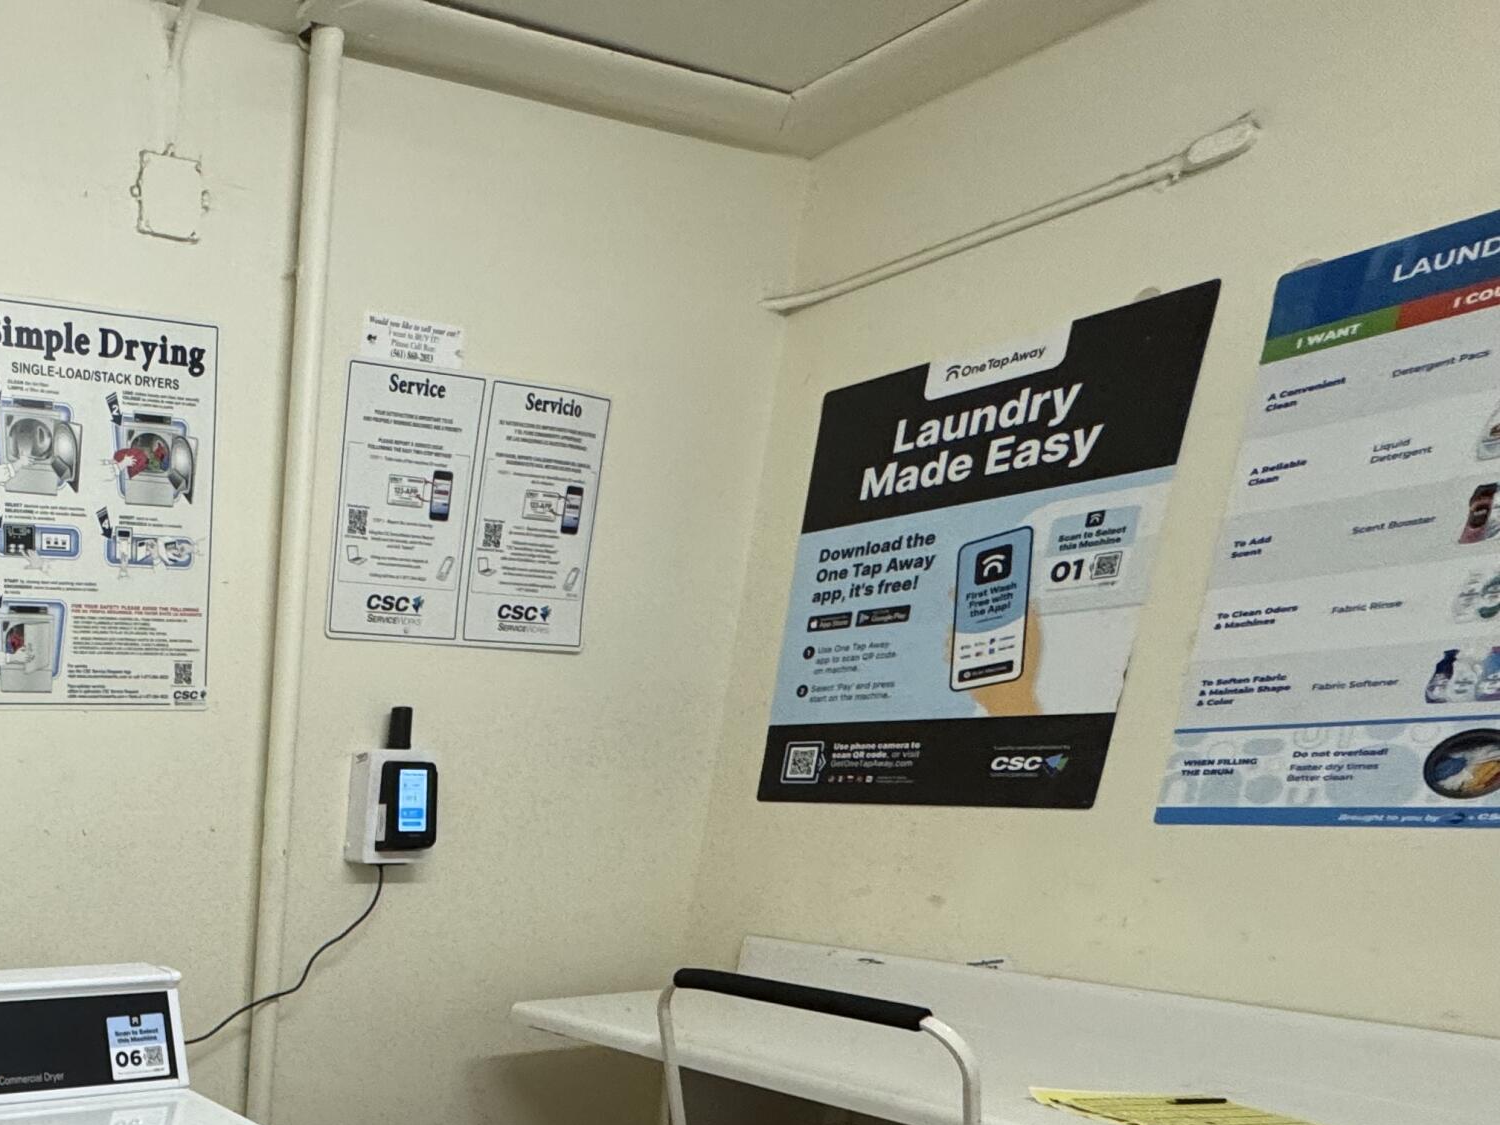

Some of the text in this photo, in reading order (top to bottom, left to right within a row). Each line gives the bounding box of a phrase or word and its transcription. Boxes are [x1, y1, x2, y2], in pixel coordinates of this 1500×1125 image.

[1453, 297, 1461, 308] I
[1296, 322, 1362, 350] I WANT
[98, 328, 206, 378] Drying
[1392, 350, 1491, 378] Detergent Pacs
[11, 362, 180, 390] SINGLE-LOAD/STACK DRYERS
[388, 374, 446, 399] Service
[1267, 377, 1346, 402] A Convenient
[112, 404, 120, 415] 2
[525, 392, 582, 418] Servicio
[1265, 400, 1298, 412] Clean
[893, 382, 1083, 454] Laundry
[1373, 438, 1412, 453] Liquid
[859, 423, 1105, 501] Made Easy
[1370, 445, 1433, 465] Detergent
[1250, 459, 1308, 476] A Reliable
[1248, 475, 1280, 487] Clean
[1351, 516, 1436, 536] Scent Booster
[1058, 533, 1081, 542] Scan
[1095, 526, 1126, 537] Select
[819, 533, 936, 563] Download the
[1059, 537, 1121, 551] this Machine
[1233, 536, 1272, 549] To Add
[1230, 548, 1263, 559] Scent
[816, 554, 937, 583] One Tap Away
[1050, 559, 1085, 583] 01
[812, 575, 919, 606] app, it's free!
[966, 581, 1017, 600] First Wash
[992, 592, 1013, 603] with
[366, 593, 410, 612] CSC
[970, 601, 1011, 617] the App!
[1331, 600, 1404, 615] Fabric Rinse
[497, 604, 538, 621] CSC
[1217, 604, 1299, 620] To Clean Odors
[1225, 618, 1276, 629] Machines
[1216, 677, 1250, 685] Soften
[1252, 674, 1287, 683] Fabric
[1312, 679, 1399, 691] Fabric Softener
[173, 690, 198, 699] CSC
[1209, 686, 1254, 696] Maintain
[1256, 684, 1291, 694] Shape
[1206, 698, 1235, 706] Color
[850, 742, 876, 751] phone
[1311, 750, 1330, 758] not
[1333, 748, 1389, 758] overload!
[991, 756, 1043, 771] CSC
[1217, 757, 1258, 765] FILLING
[1325, 763, 1344, 772] dry
[1346, 763, 1379, 771] times
[1202, 768, 1234, 776] DRUM
[1287, 773, 1354, 782] Better clean
[115, 1049, 142, 1068] 06
[0, 1073, 43, 1086] Commercial
[44, 1071, 65, 1084] Dryer
